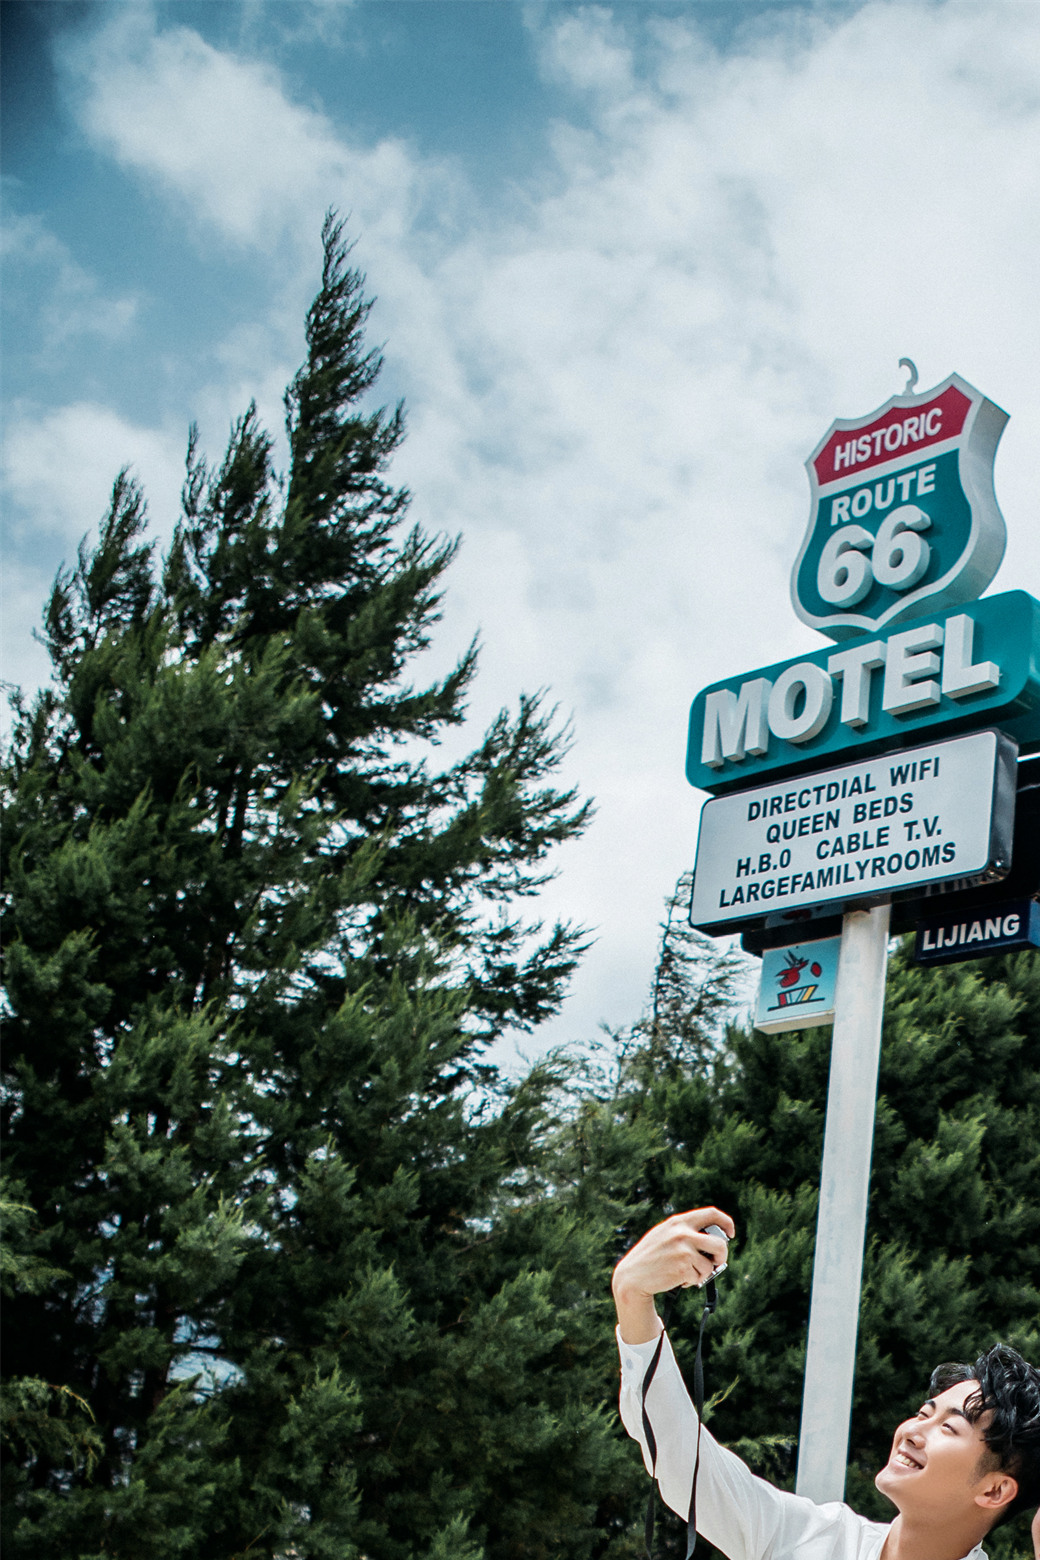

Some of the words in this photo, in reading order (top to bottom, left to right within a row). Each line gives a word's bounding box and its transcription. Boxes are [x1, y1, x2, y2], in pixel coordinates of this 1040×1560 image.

[834, 407, 942, 471] HISTORIC
[830, 463, 936, 526] ROUTE
[817, 504, 931, 608] 66
[701, 613, 1000, 769] MOTEL
[747, 773, 876, 822] DIRECTDIAL
[890, 757, 940, 787] WIFI
[766, 808, 840, 844] QUEEN
[853, 792, 914, 824] BEDS
[816, 826, 890, 860] CABLE
[903, 815, 942, 842] T.V.
[719, 841, 956, 908] LARGEFAMILYROOMS
[922, 913, 1020, 951] LIJIANG
